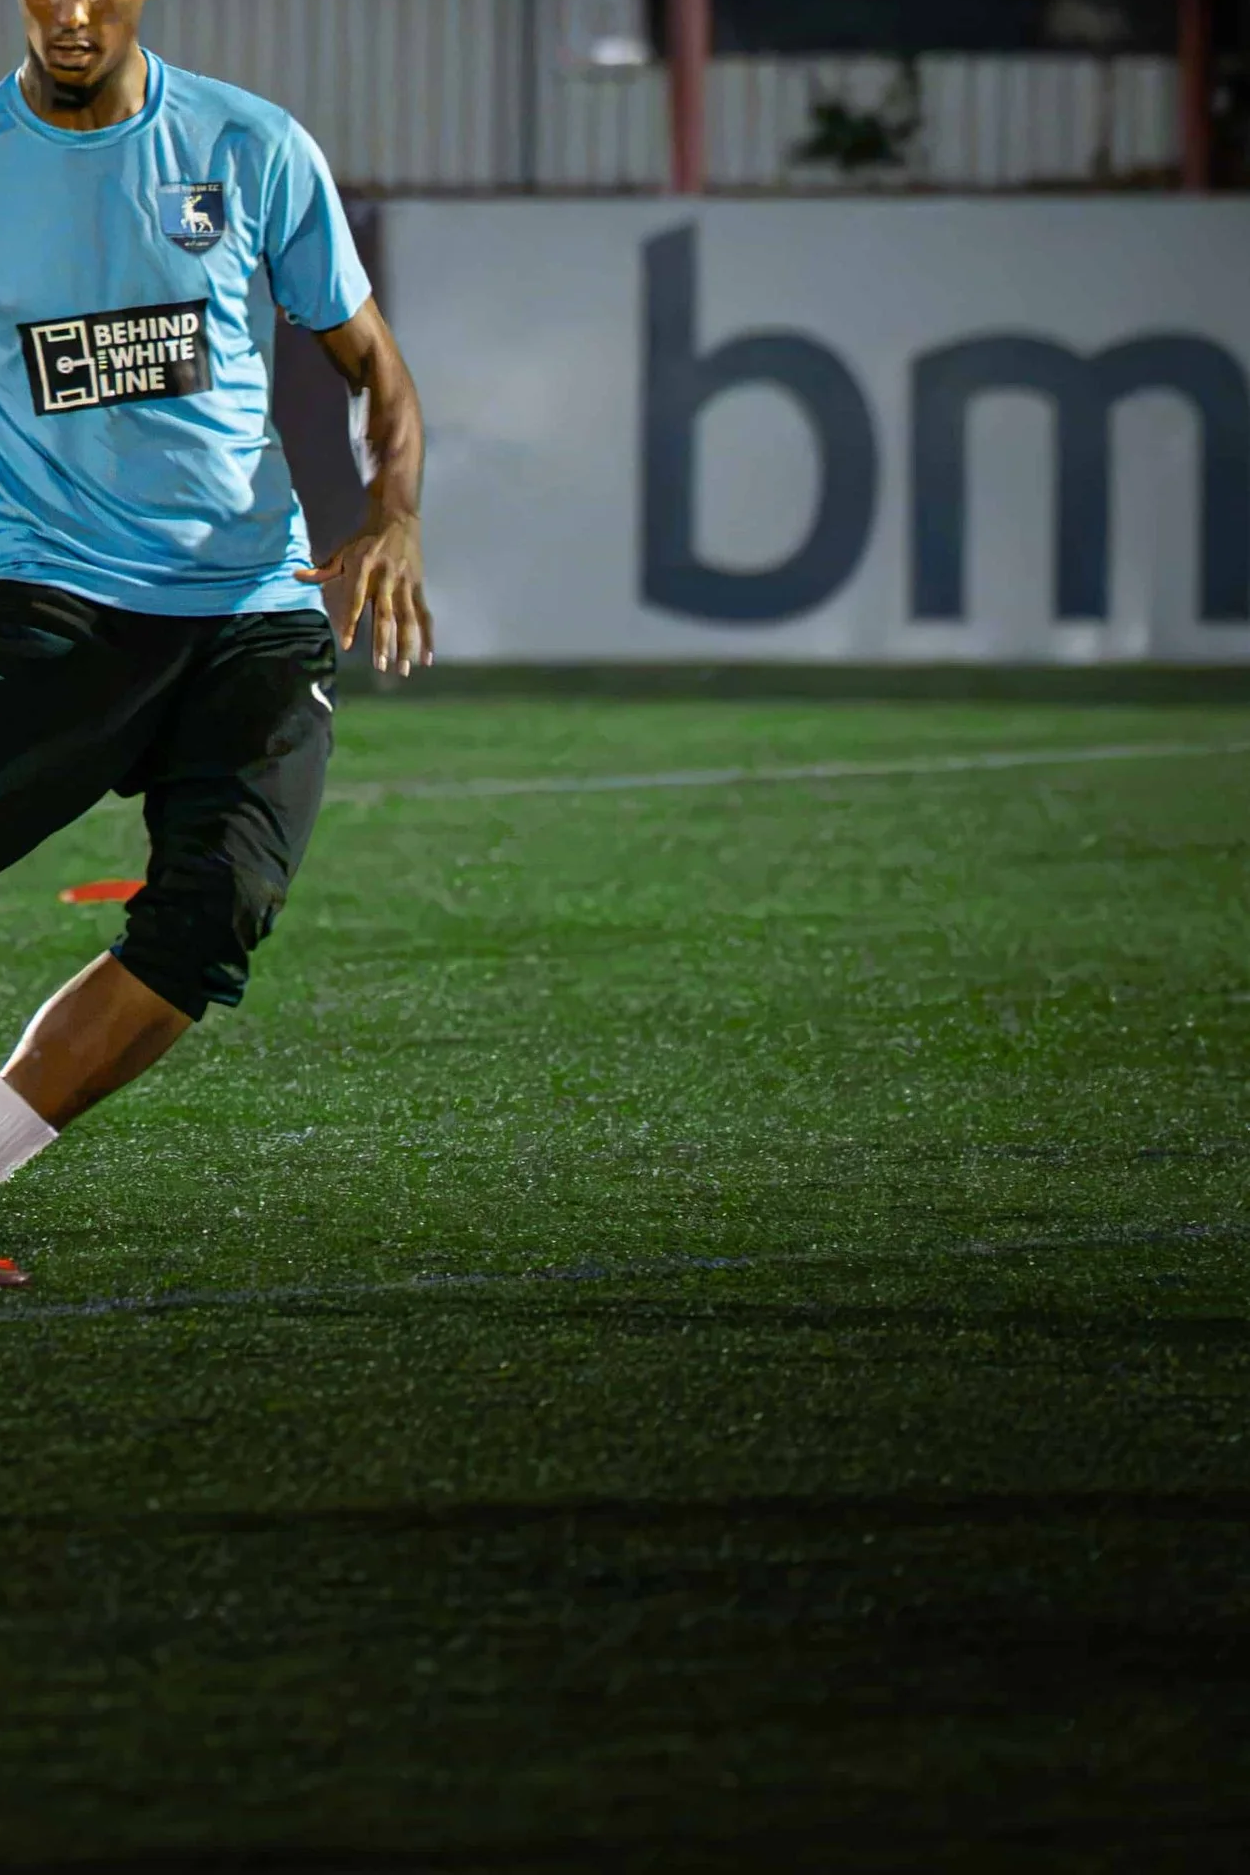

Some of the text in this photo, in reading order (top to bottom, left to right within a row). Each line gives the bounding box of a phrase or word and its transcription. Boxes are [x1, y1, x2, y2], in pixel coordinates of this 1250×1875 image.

[93, 312, 199, 347] BEHIND
[108, 337, 195, 370] WHITE
[99, 366, 166, 397] LINE
[639, 219, 1250, 628] bm
